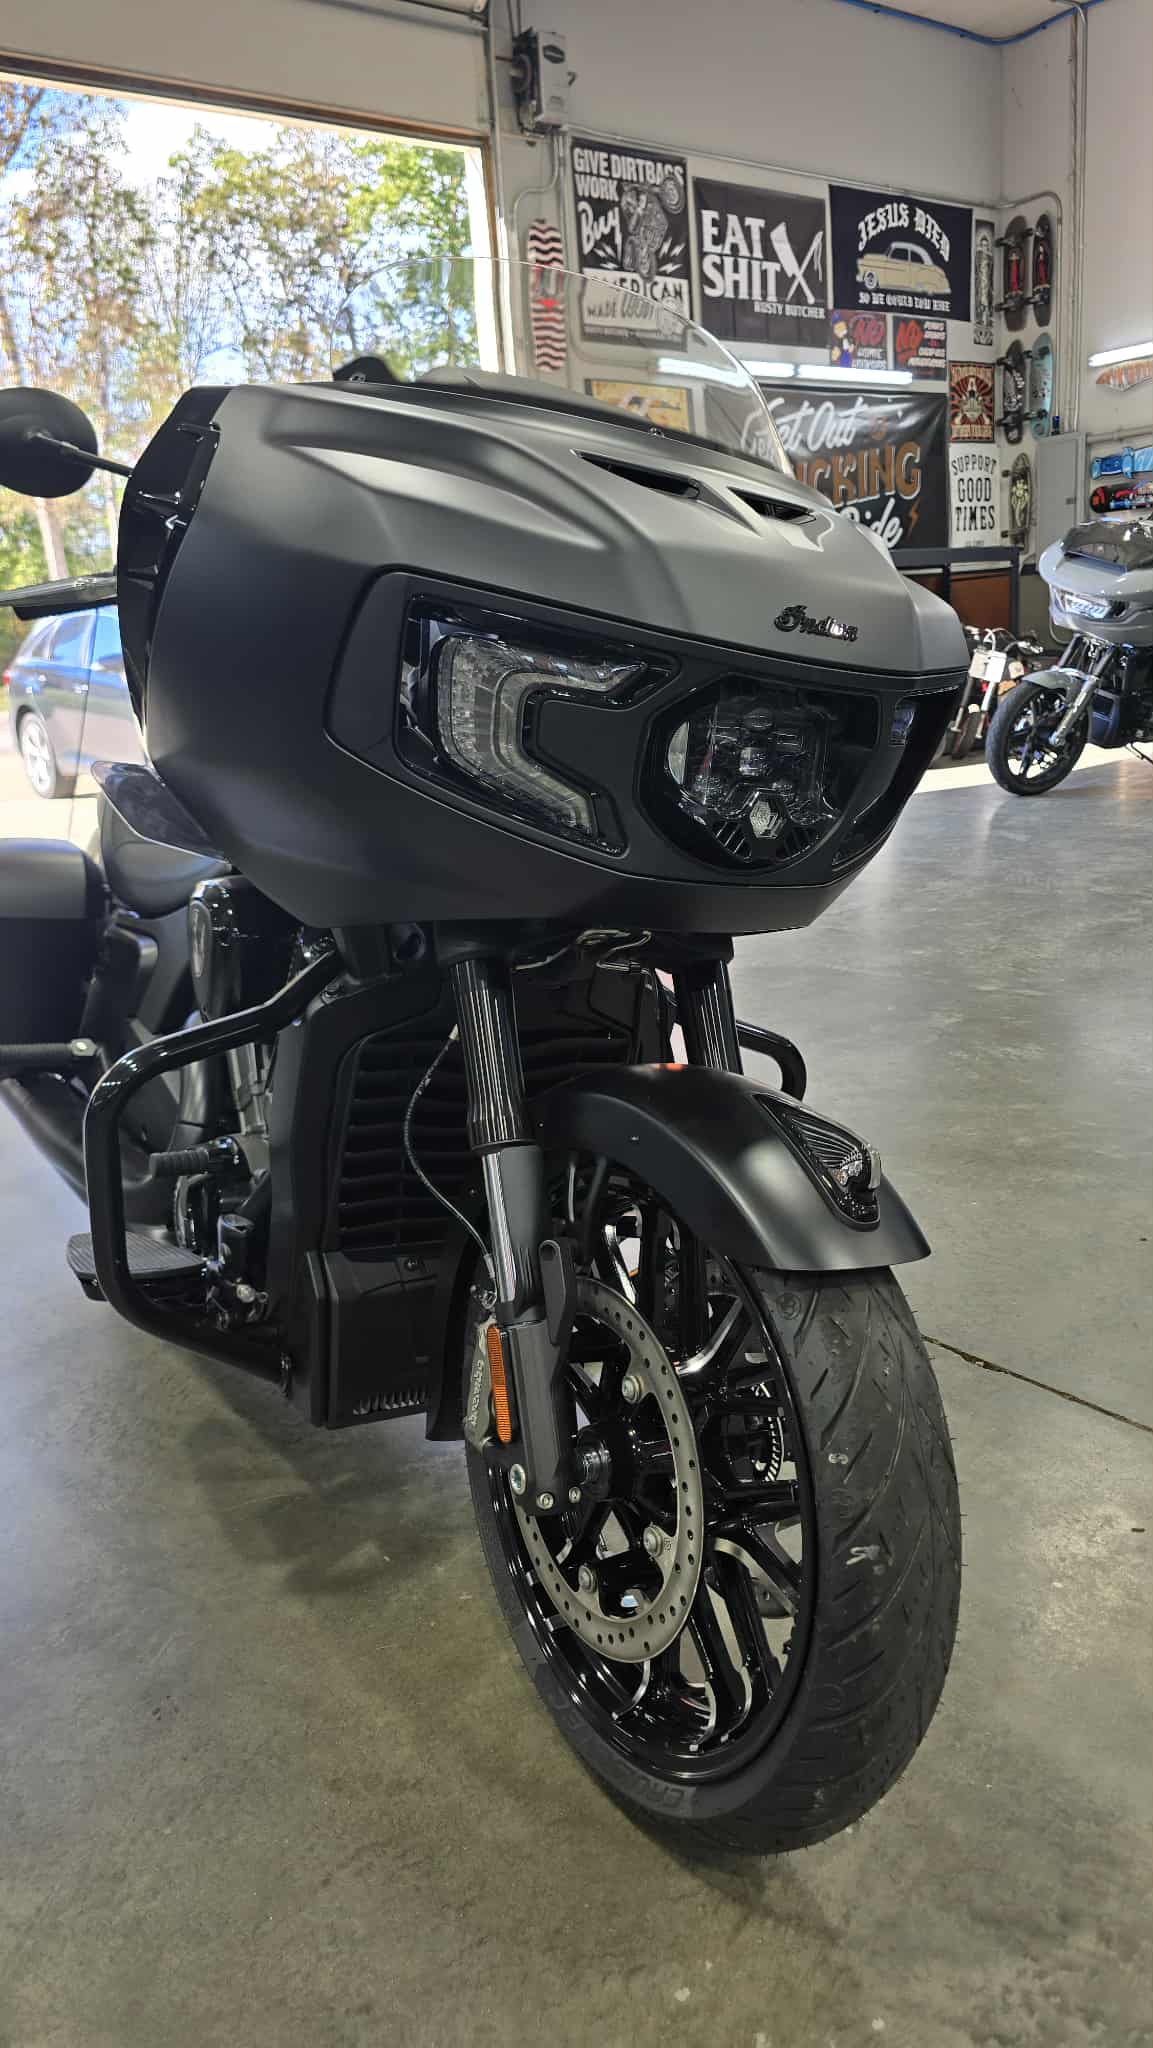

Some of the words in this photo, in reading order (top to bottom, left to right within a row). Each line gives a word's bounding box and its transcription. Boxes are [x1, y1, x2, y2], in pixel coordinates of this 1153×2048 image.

[573, 147, 610, 177] GIVE
[575, 173, 619, 202] WORK
[701, 209, 766, 259] EAT
[858, 202, 909, 251] JESUS
[914, 207, 950, 262] DIED
[702, 254, 781, 302] SHIT
[754, 301, 784, 316] RUSTY
[785, 304, 826, 320] BUTCHER
[951, 454, 997, 476] SUPPORT
[957, 477, 992, 503] GOOD
[955, 505, 995, 533] TIMES
[774, 604, 859, 642] Indian
